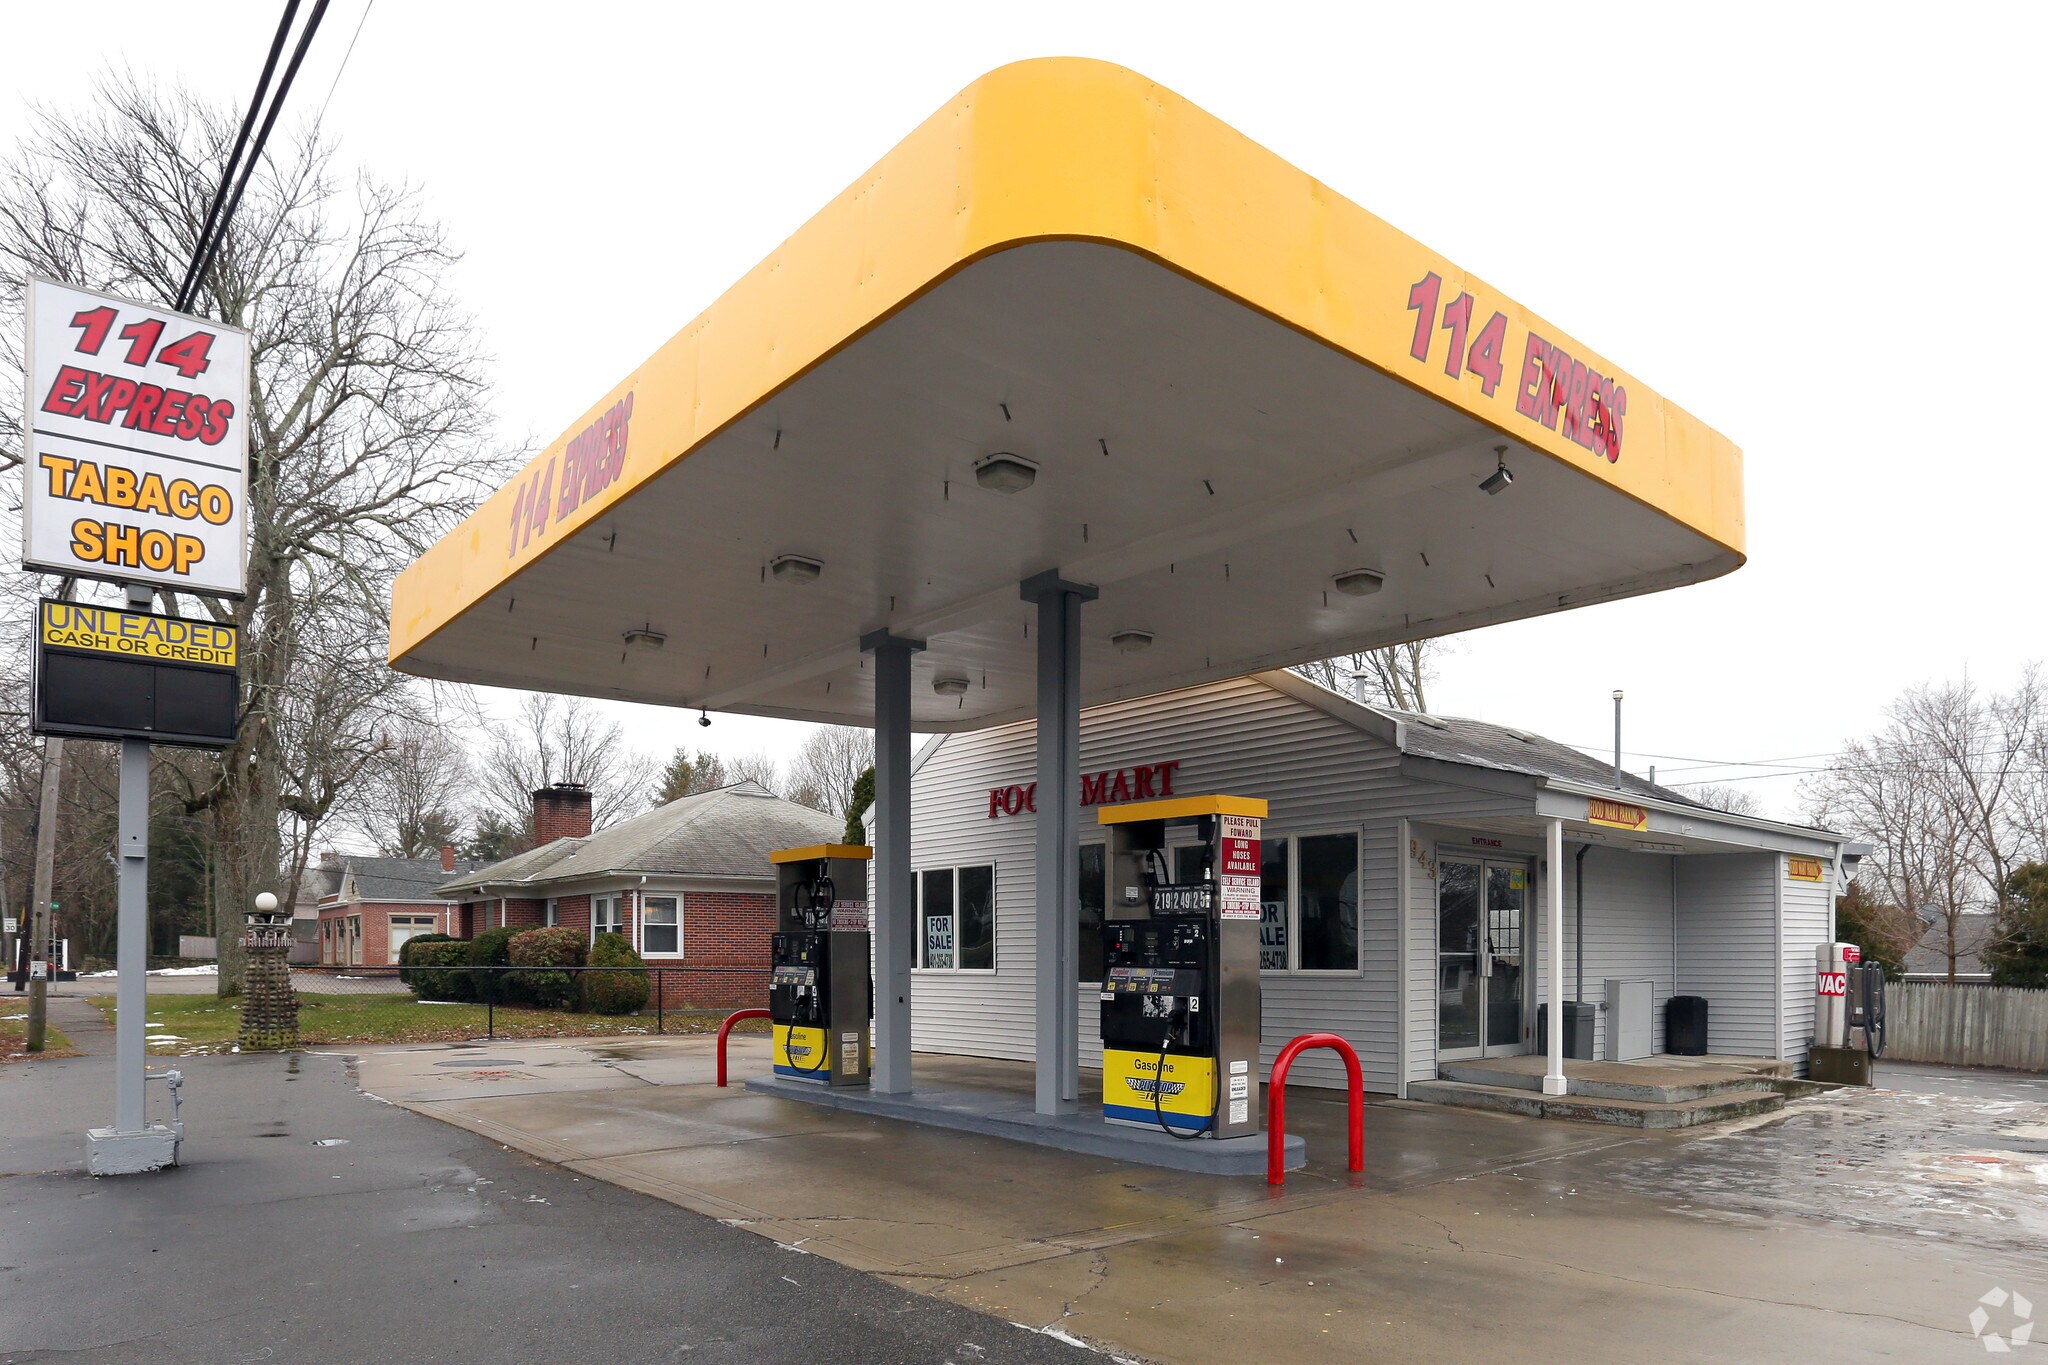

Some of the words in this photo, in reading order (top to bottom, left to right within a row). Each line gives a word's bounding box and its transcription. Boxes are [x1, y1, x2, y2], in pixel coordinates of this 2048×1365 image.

[68, 305, 217, 380] 114
[1407, 270, 1508, 398] 114
[1515, 331, 1627, 464] EXPRESS
[40, 364, 235, 446] EXPRESS
[509, 456, 556, 559] 114
[555, 391, 634, 524] EXPRESS
[39, 452, 233, 526] TABACO
[70, 518, 205, 575] SHOP
[46, 604, 234, 650] UNLEADED
[47, 629, 111, 650] CASH
[116, 638, 148, 655] OR
[155, 643, 233, 665] CREDIT
[988, 781, 1037, 818] FOO
[1079, 760, 1179, 807] MART
[1224, 816, 1244, 826] PLEASE
[1246, 818, 1259, 828] PULL
[1230, 828, 1253, 838] FOWARD
[1234, 840, 1249, 849] LONG
[1472, 837, 1502, 848] ENTRANCE
[1232, 851, 1250, 860] HOSES
[1227, 861, 1256, 871] AVAILABLE
[1260, 904, 1278, 923] OR
[930, 918, 948, 932] FOR
[930, 935, 951, 949] SALE
[1260, 927, 1285, 945] ALE
[1818, 974, 1845, 994] VAC
[1191, 998, 1198, 1010] 2
[1134, 1059, 1174, 1073] Gasone
[1145, 1092, 1163, 1101] FUL
